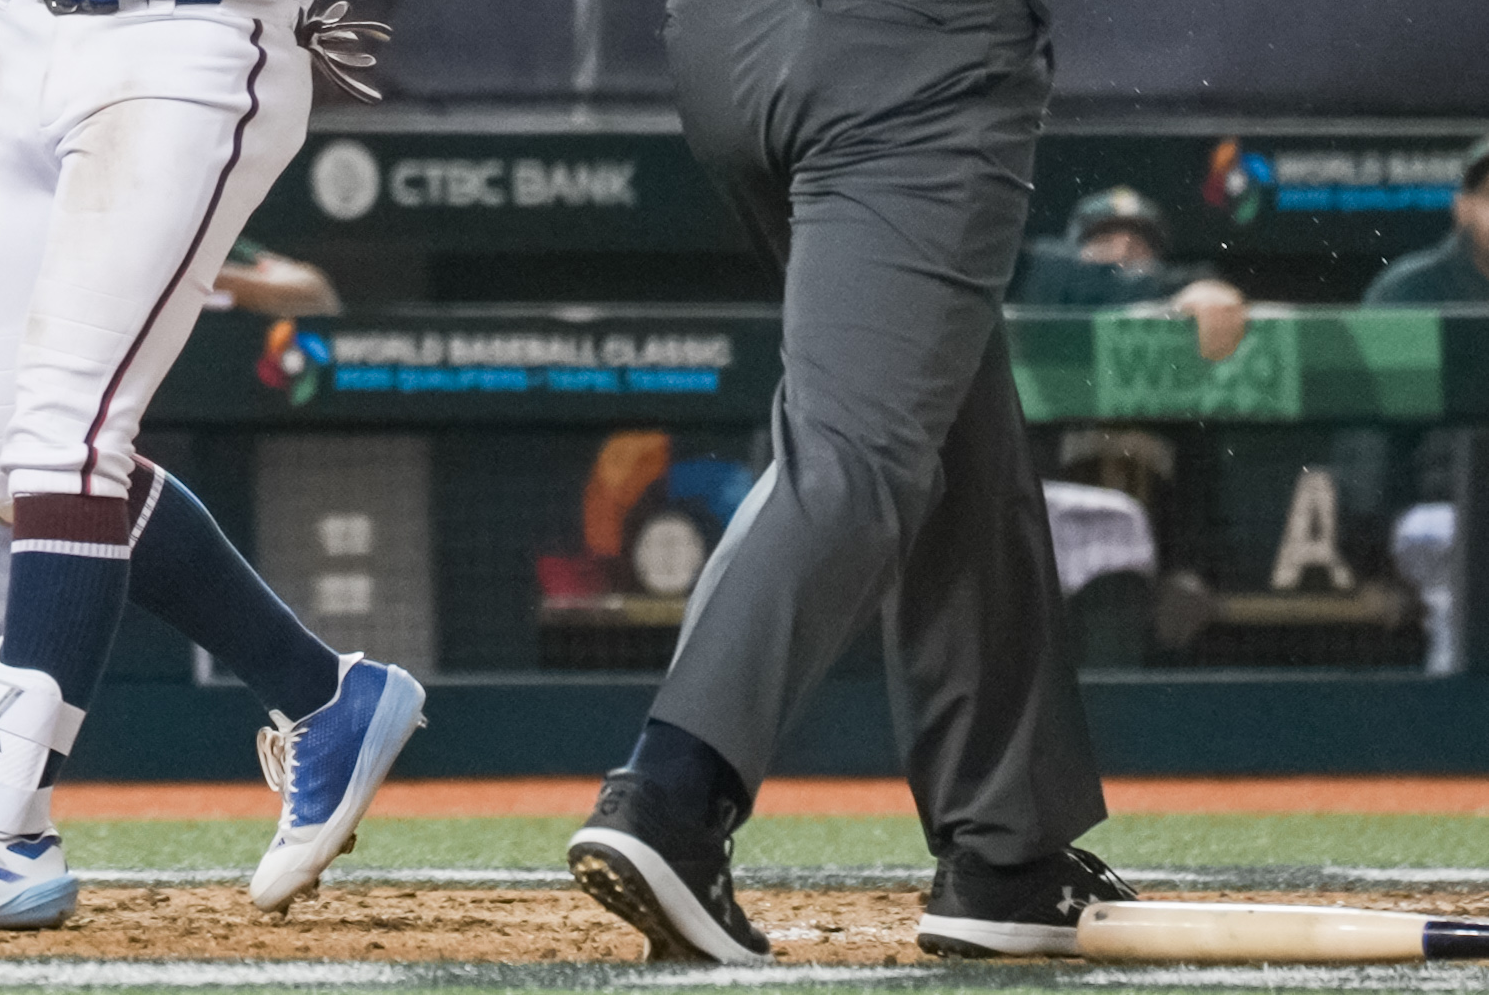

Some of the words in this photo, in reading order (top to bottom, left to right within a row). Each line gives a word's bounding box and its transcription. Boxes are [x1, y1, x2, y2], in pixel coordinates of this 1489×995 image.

[389, 159, 506, 206] CTBC
[513, 159, 637, 206] BANK
[333, 333, 444, 366] WORLD
[448, 333, 598, 367] BASEBALL
[602, 334, 732, 368] CLASSIC
